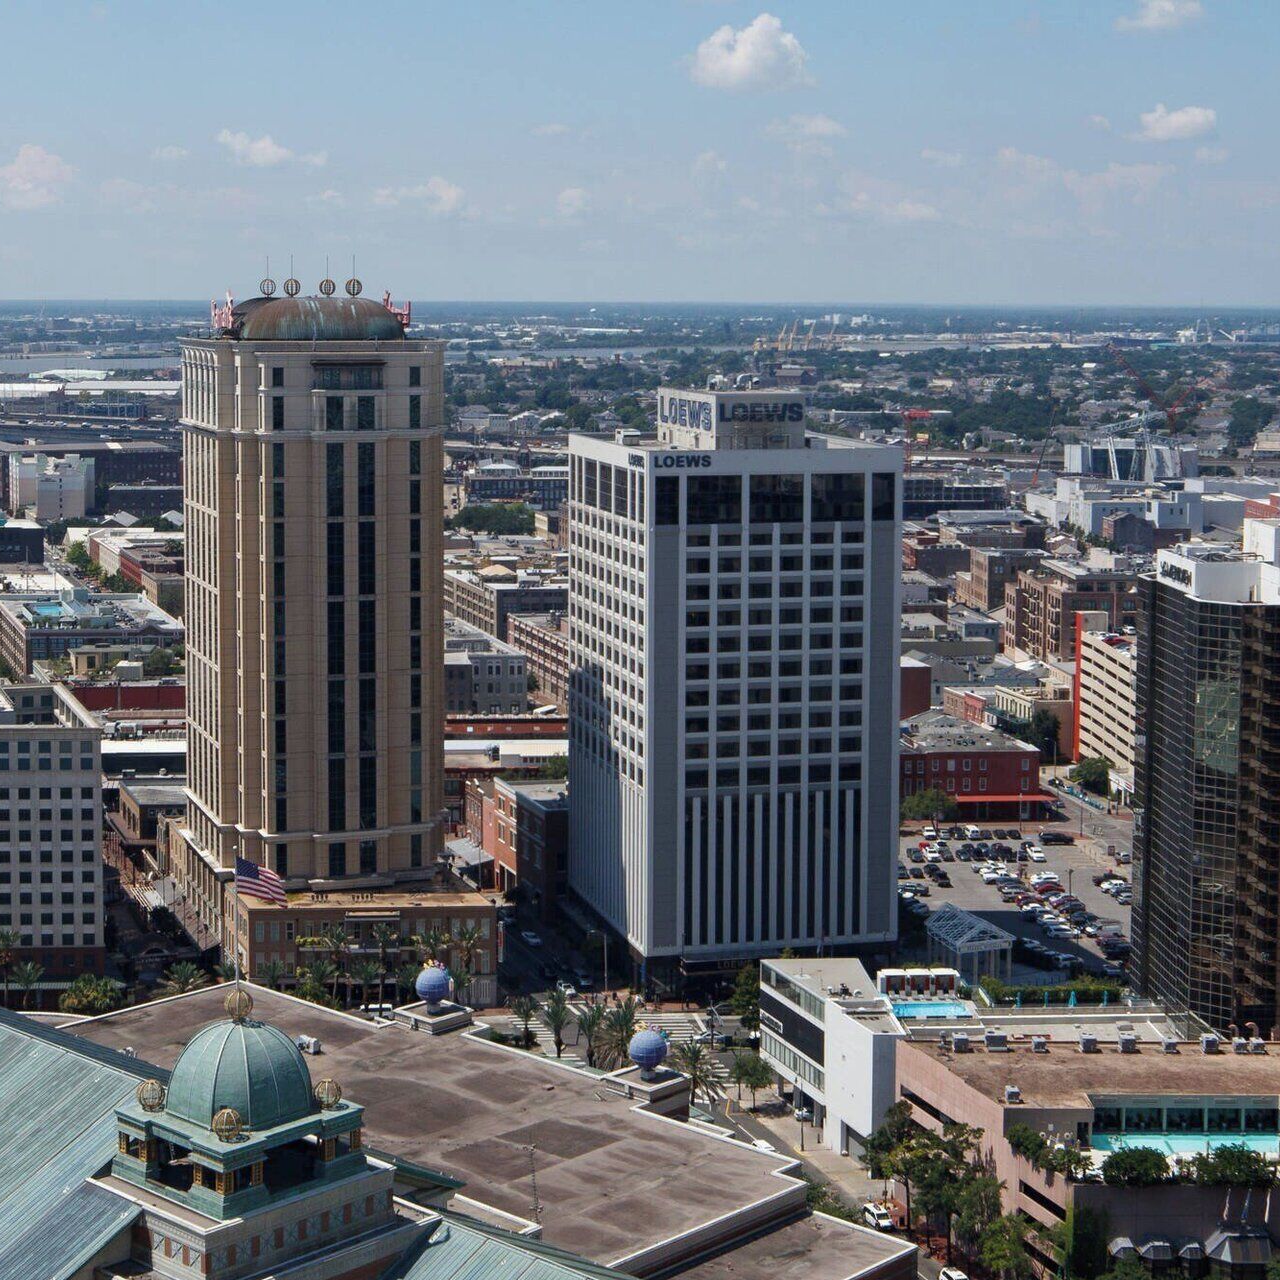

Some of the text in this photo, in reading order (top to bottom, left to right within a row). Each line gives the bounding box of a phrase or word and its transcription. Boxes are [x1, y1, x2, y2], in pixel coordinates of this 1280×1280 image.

[660, 395, 712, 432] LOEWS
[720, 402, 803, 423] LOEWS
[654, 454, 712, 469] LOEWS
